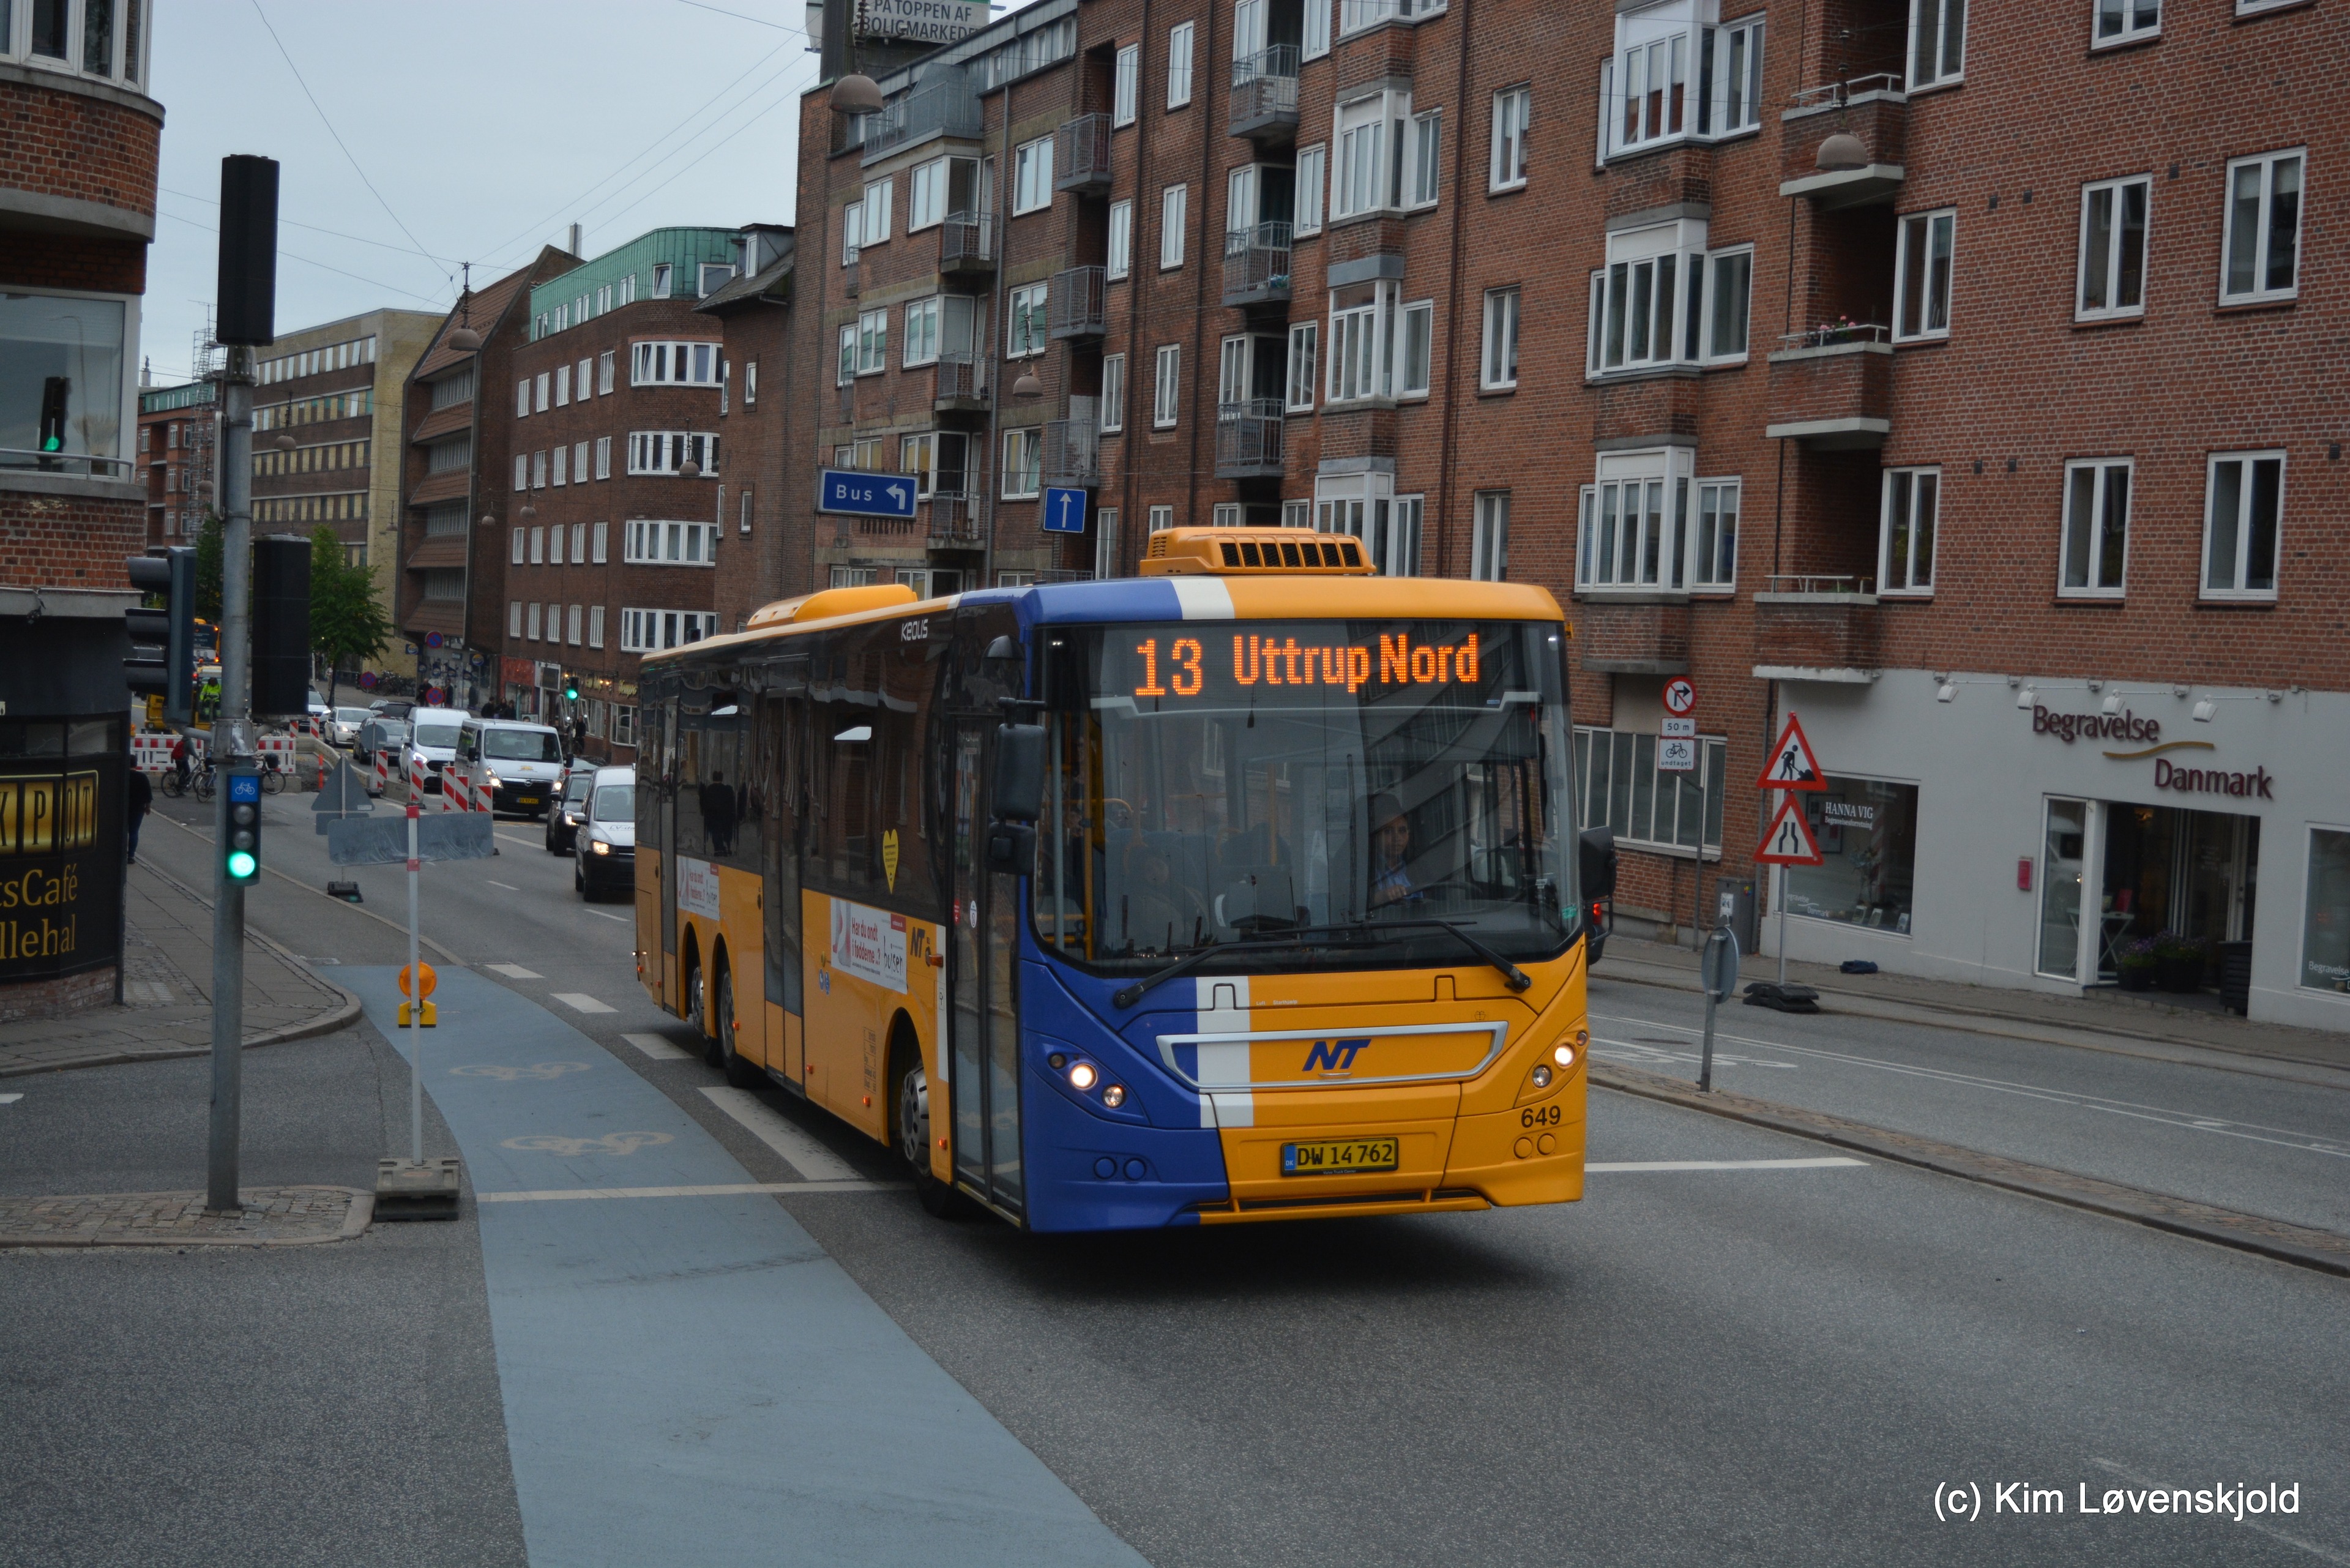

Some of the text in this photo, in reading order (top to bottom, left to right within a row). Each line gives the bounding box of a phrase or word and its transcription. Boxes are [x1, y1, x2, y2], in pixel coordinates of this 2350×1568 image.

[896, 0, 950, 20] TOPPEN
[955, 6, 972, 22] AF
[862, 16, 978, 40] BOLIGMARKED
[836, 484, 872, 501] Bus
[1135, 634, 1478, 695] 13 Uttrup Nord
[2032, 705, 2160, 744] Begravelse
[2154, 758, 2272, 799] Danmark
[1825, 802, 1873, 819] HANNA VIG
[860, 919, 867, 938] du
[867, 923, 878, 942] ondt
[910, 926, 925, 958] NT
[2308, 961, 2349, 976] Begravelse
[1302, 1039, 1371, 1071] NT
[1521, 1105, 1561, 1128] 649
[1297, 1146, 1324, 1166] DW
[1330, 1145, 1352, 1165] 14
[1357, 1143, 1393, 1163] 762
